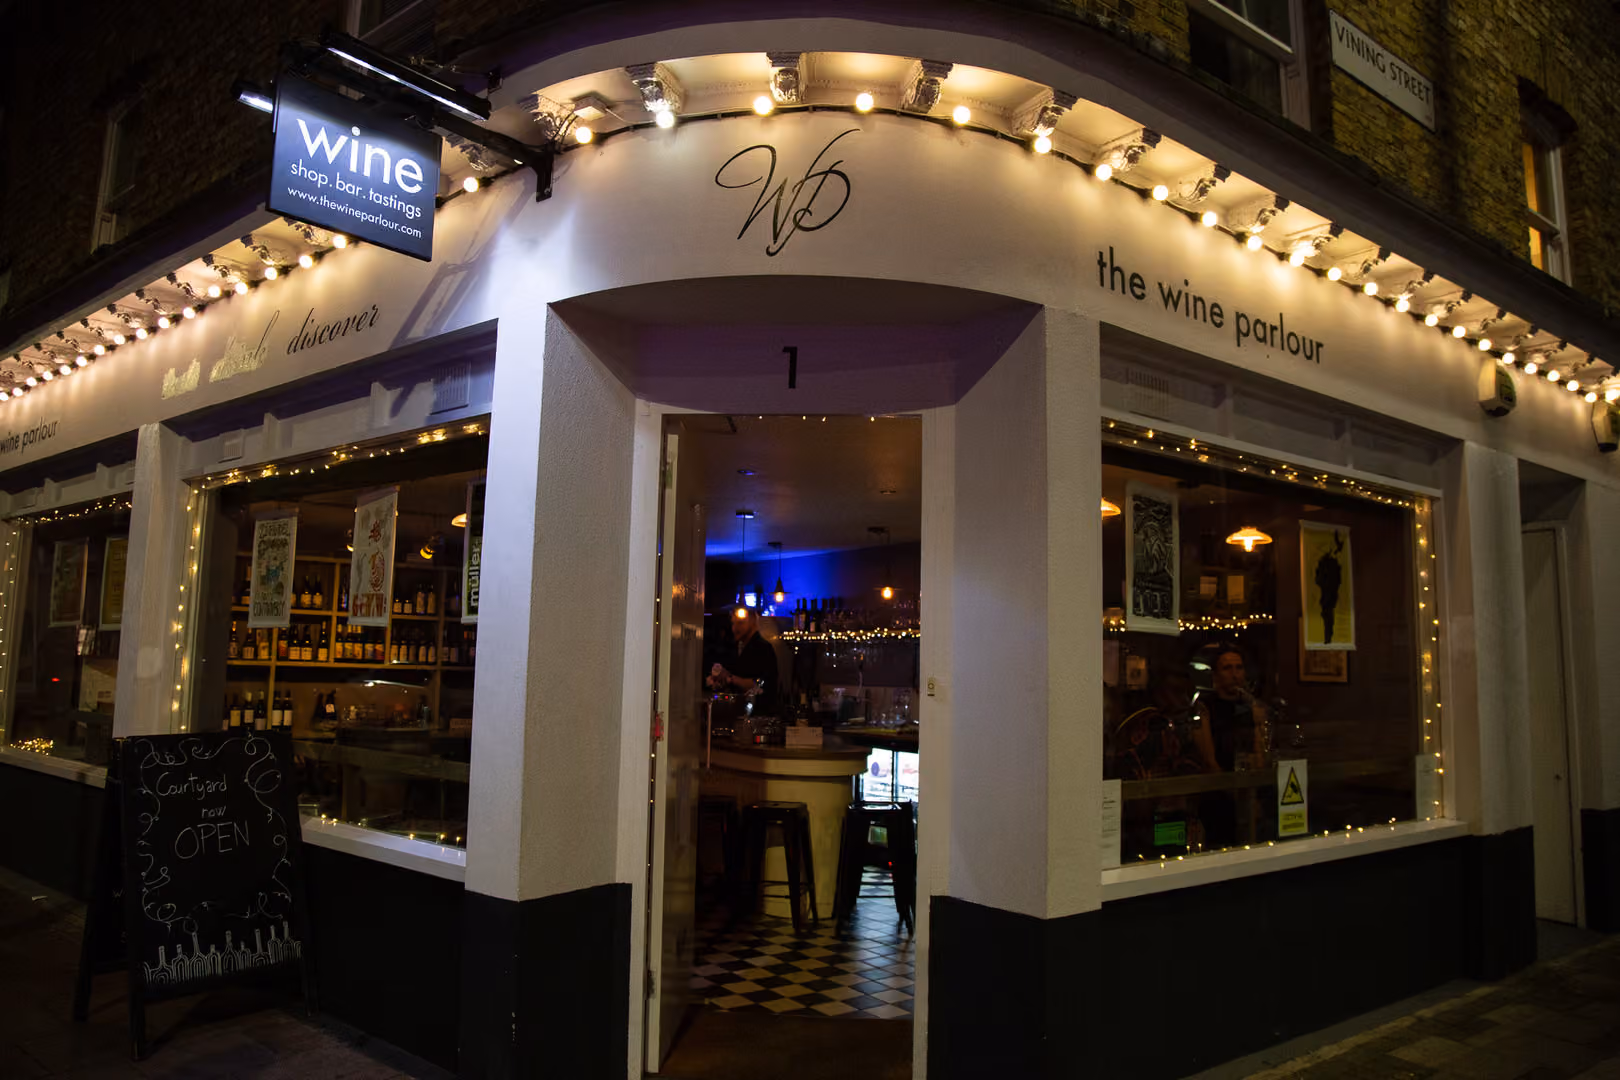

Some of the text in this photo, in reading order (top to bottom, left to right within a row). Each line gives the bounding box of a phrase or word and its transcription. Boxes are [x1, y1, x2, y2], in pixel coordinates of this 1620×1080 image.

[1335, 21, 1431, 104] VINING STREET
[297, 118, 423, 194] wine
[287, 186, 422, 239] www.thewineparlour.com
[369, 187, 422, 220] tastings
[1097, 246, 1324, 364] the wine parlour
[286, 304, 380, 356] discover
[782, 346, 798, 389] 1
[22, 416, 58, 454] parlour
[156, 771, 228, 801] Courtyard
[201, 805, 227, 819] now
[174, 819, 250, 860] OPEN
